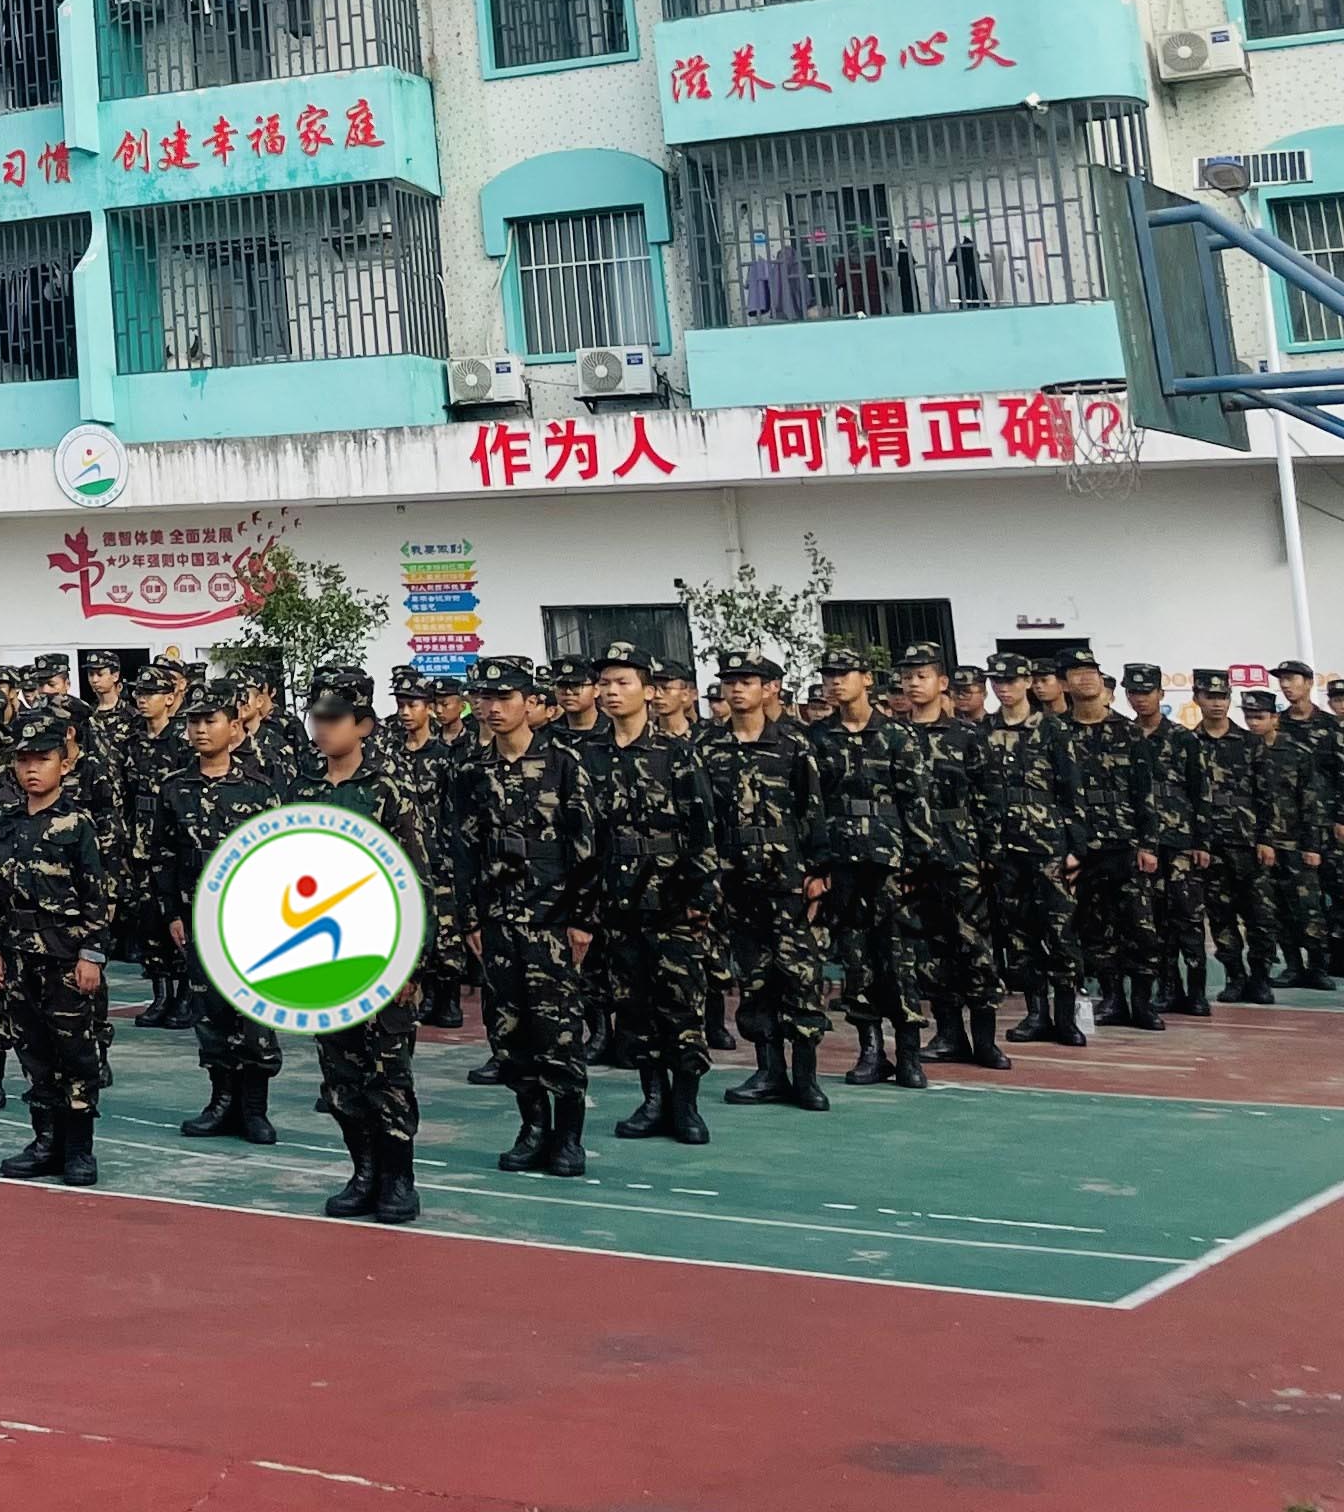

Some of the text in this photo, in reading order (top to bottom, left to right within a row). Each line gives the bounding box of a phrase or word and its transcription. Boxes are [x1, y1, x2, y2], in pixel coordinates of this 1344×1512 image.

[670, 16, 1018, 104] 滋养美好心灵
[113, 98, 385, 173] 创建幸福家庭
[469, 417, 677, 487] 作为人
[103, 527, 234, 547] 德智体美 全面发展
[118, 551, 221, 569] 少年强则中国强
